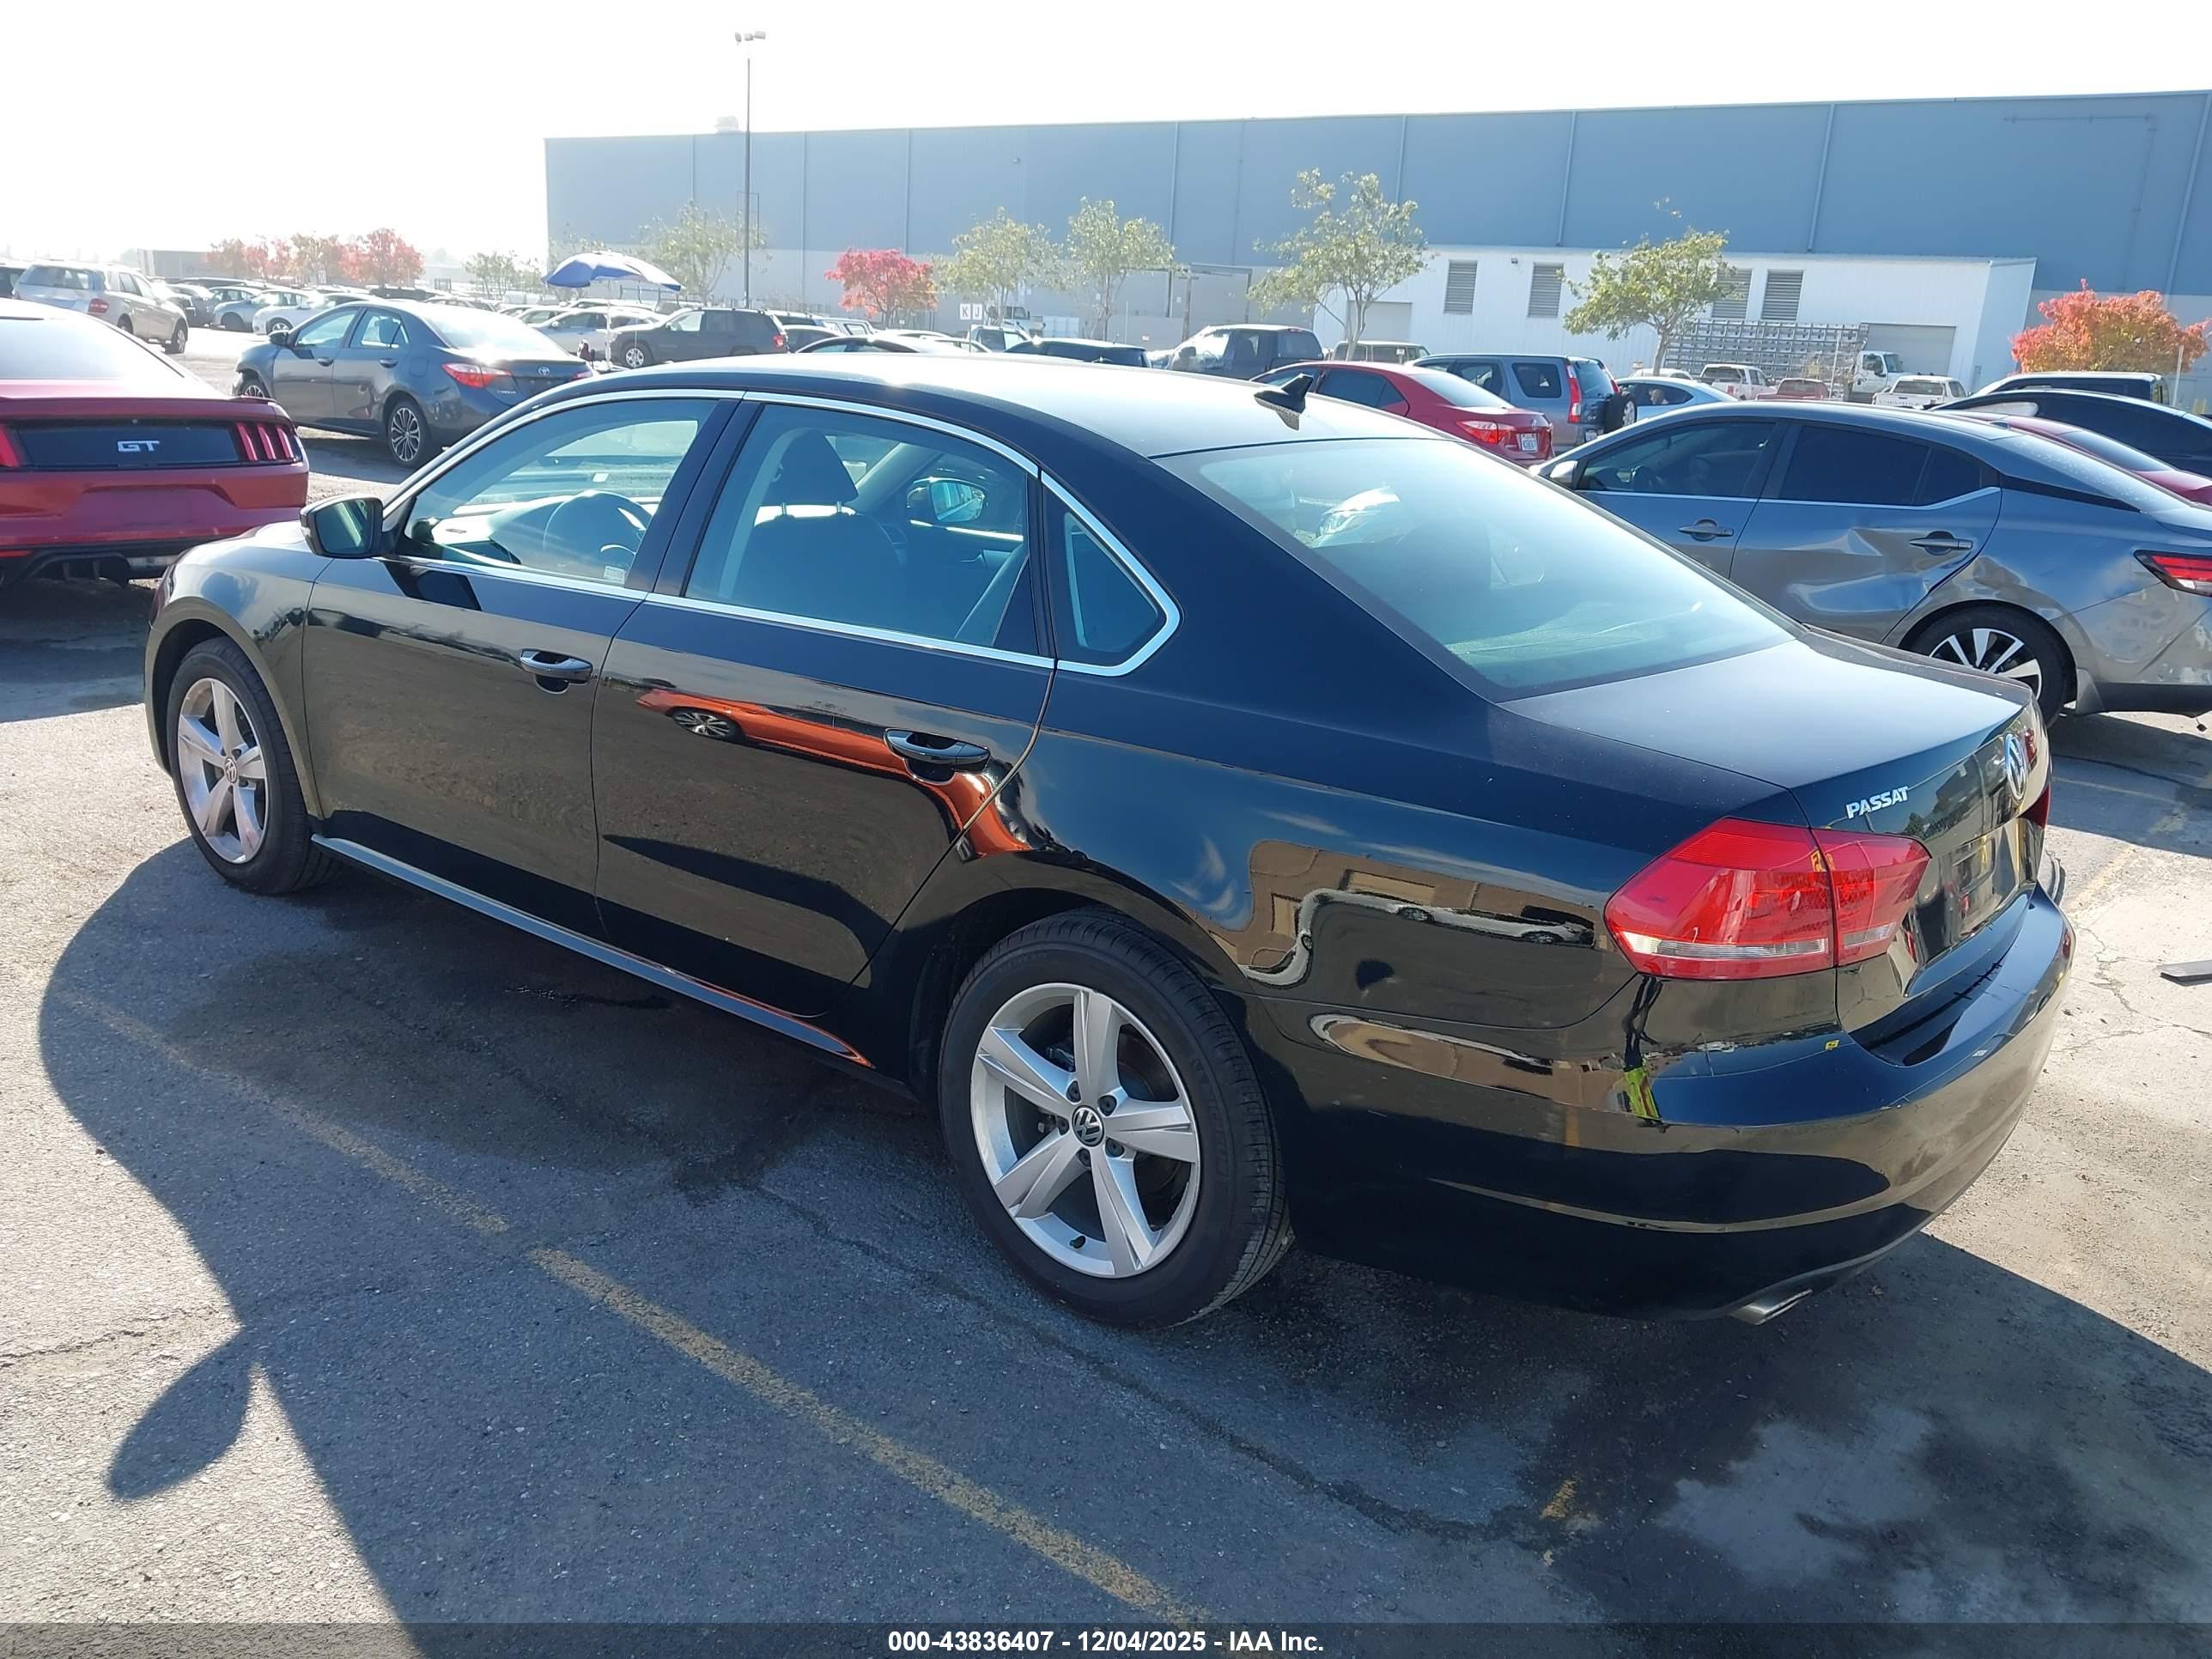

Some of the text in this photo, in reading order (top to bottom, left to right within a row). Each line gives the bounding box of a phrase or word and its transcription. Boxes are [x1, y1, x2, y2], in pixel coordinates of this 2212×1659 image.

[962, 306, 969, 317] K
[117, 440, 160, 453] GT
[1845, 786, 1909, 819] PASSAT
